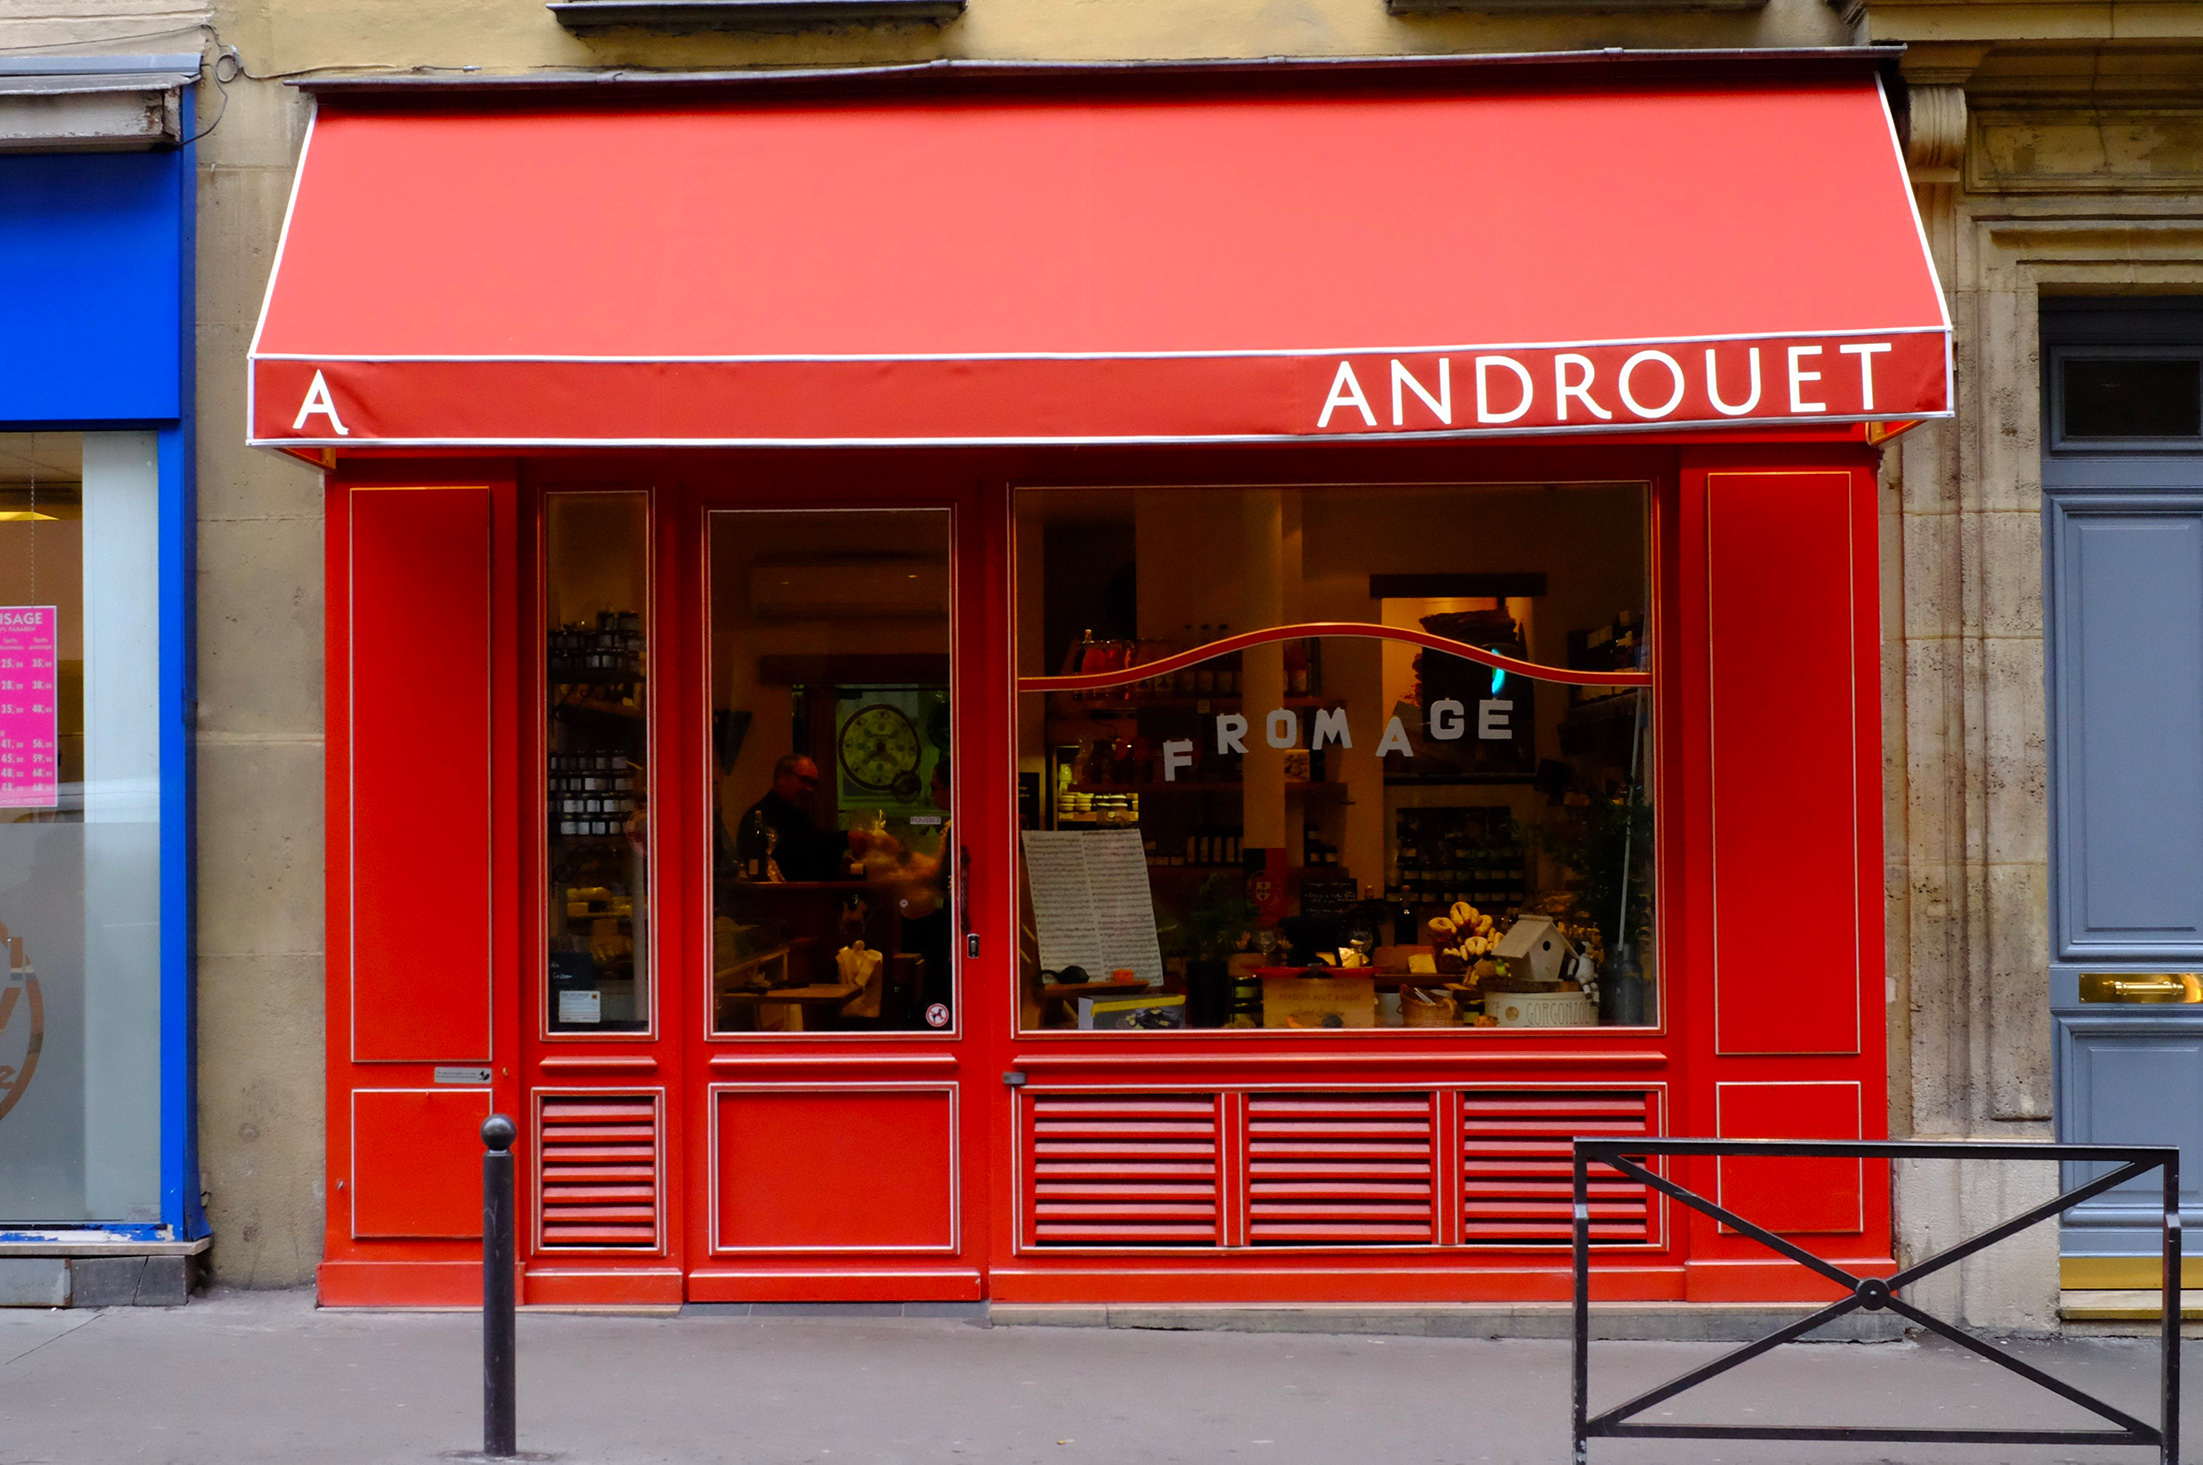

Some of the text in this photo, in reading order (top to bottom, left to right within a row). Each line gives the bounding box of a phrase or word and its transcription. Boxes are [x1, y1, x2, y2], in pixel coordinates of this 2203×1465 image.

[292, 368, 350, 436] A
[1317, 342, 1892, 428] ANDROUET
[1163, 697, 1514, 782] FROMAGE
